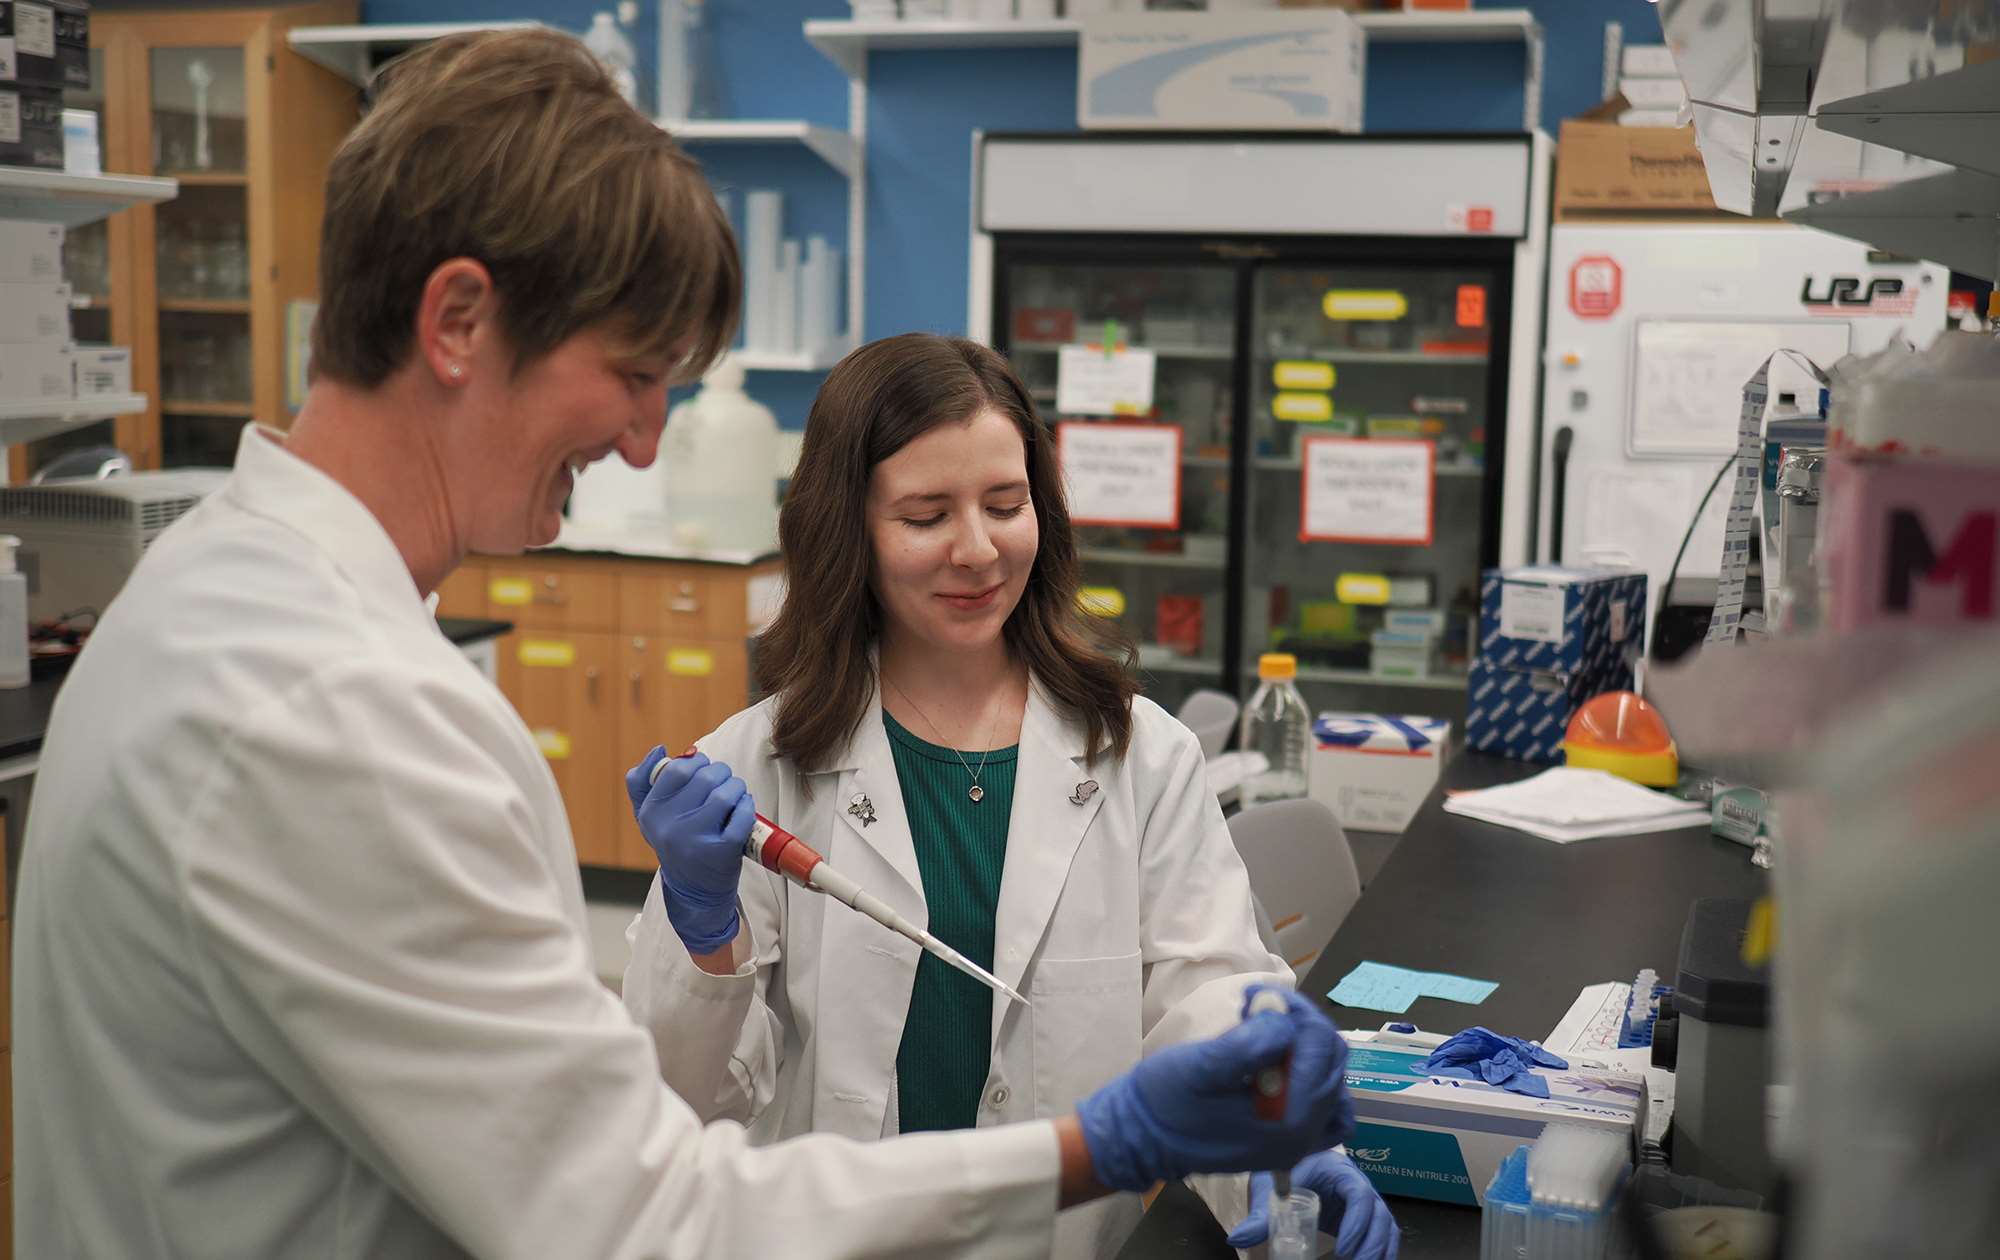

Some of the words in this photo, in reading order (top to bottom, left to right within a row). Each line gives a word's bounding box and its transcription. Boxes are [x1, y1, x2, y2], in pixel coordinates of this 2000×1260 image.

[1800, 277, 1903, 305] LRP
[1885, 508, 1996, 618] M
[1401, 1167, 1414, 1177] EN
[1415, 1169, 1449, 1183] NITRILE
[1451, 1174, 1469, 1185] 200
